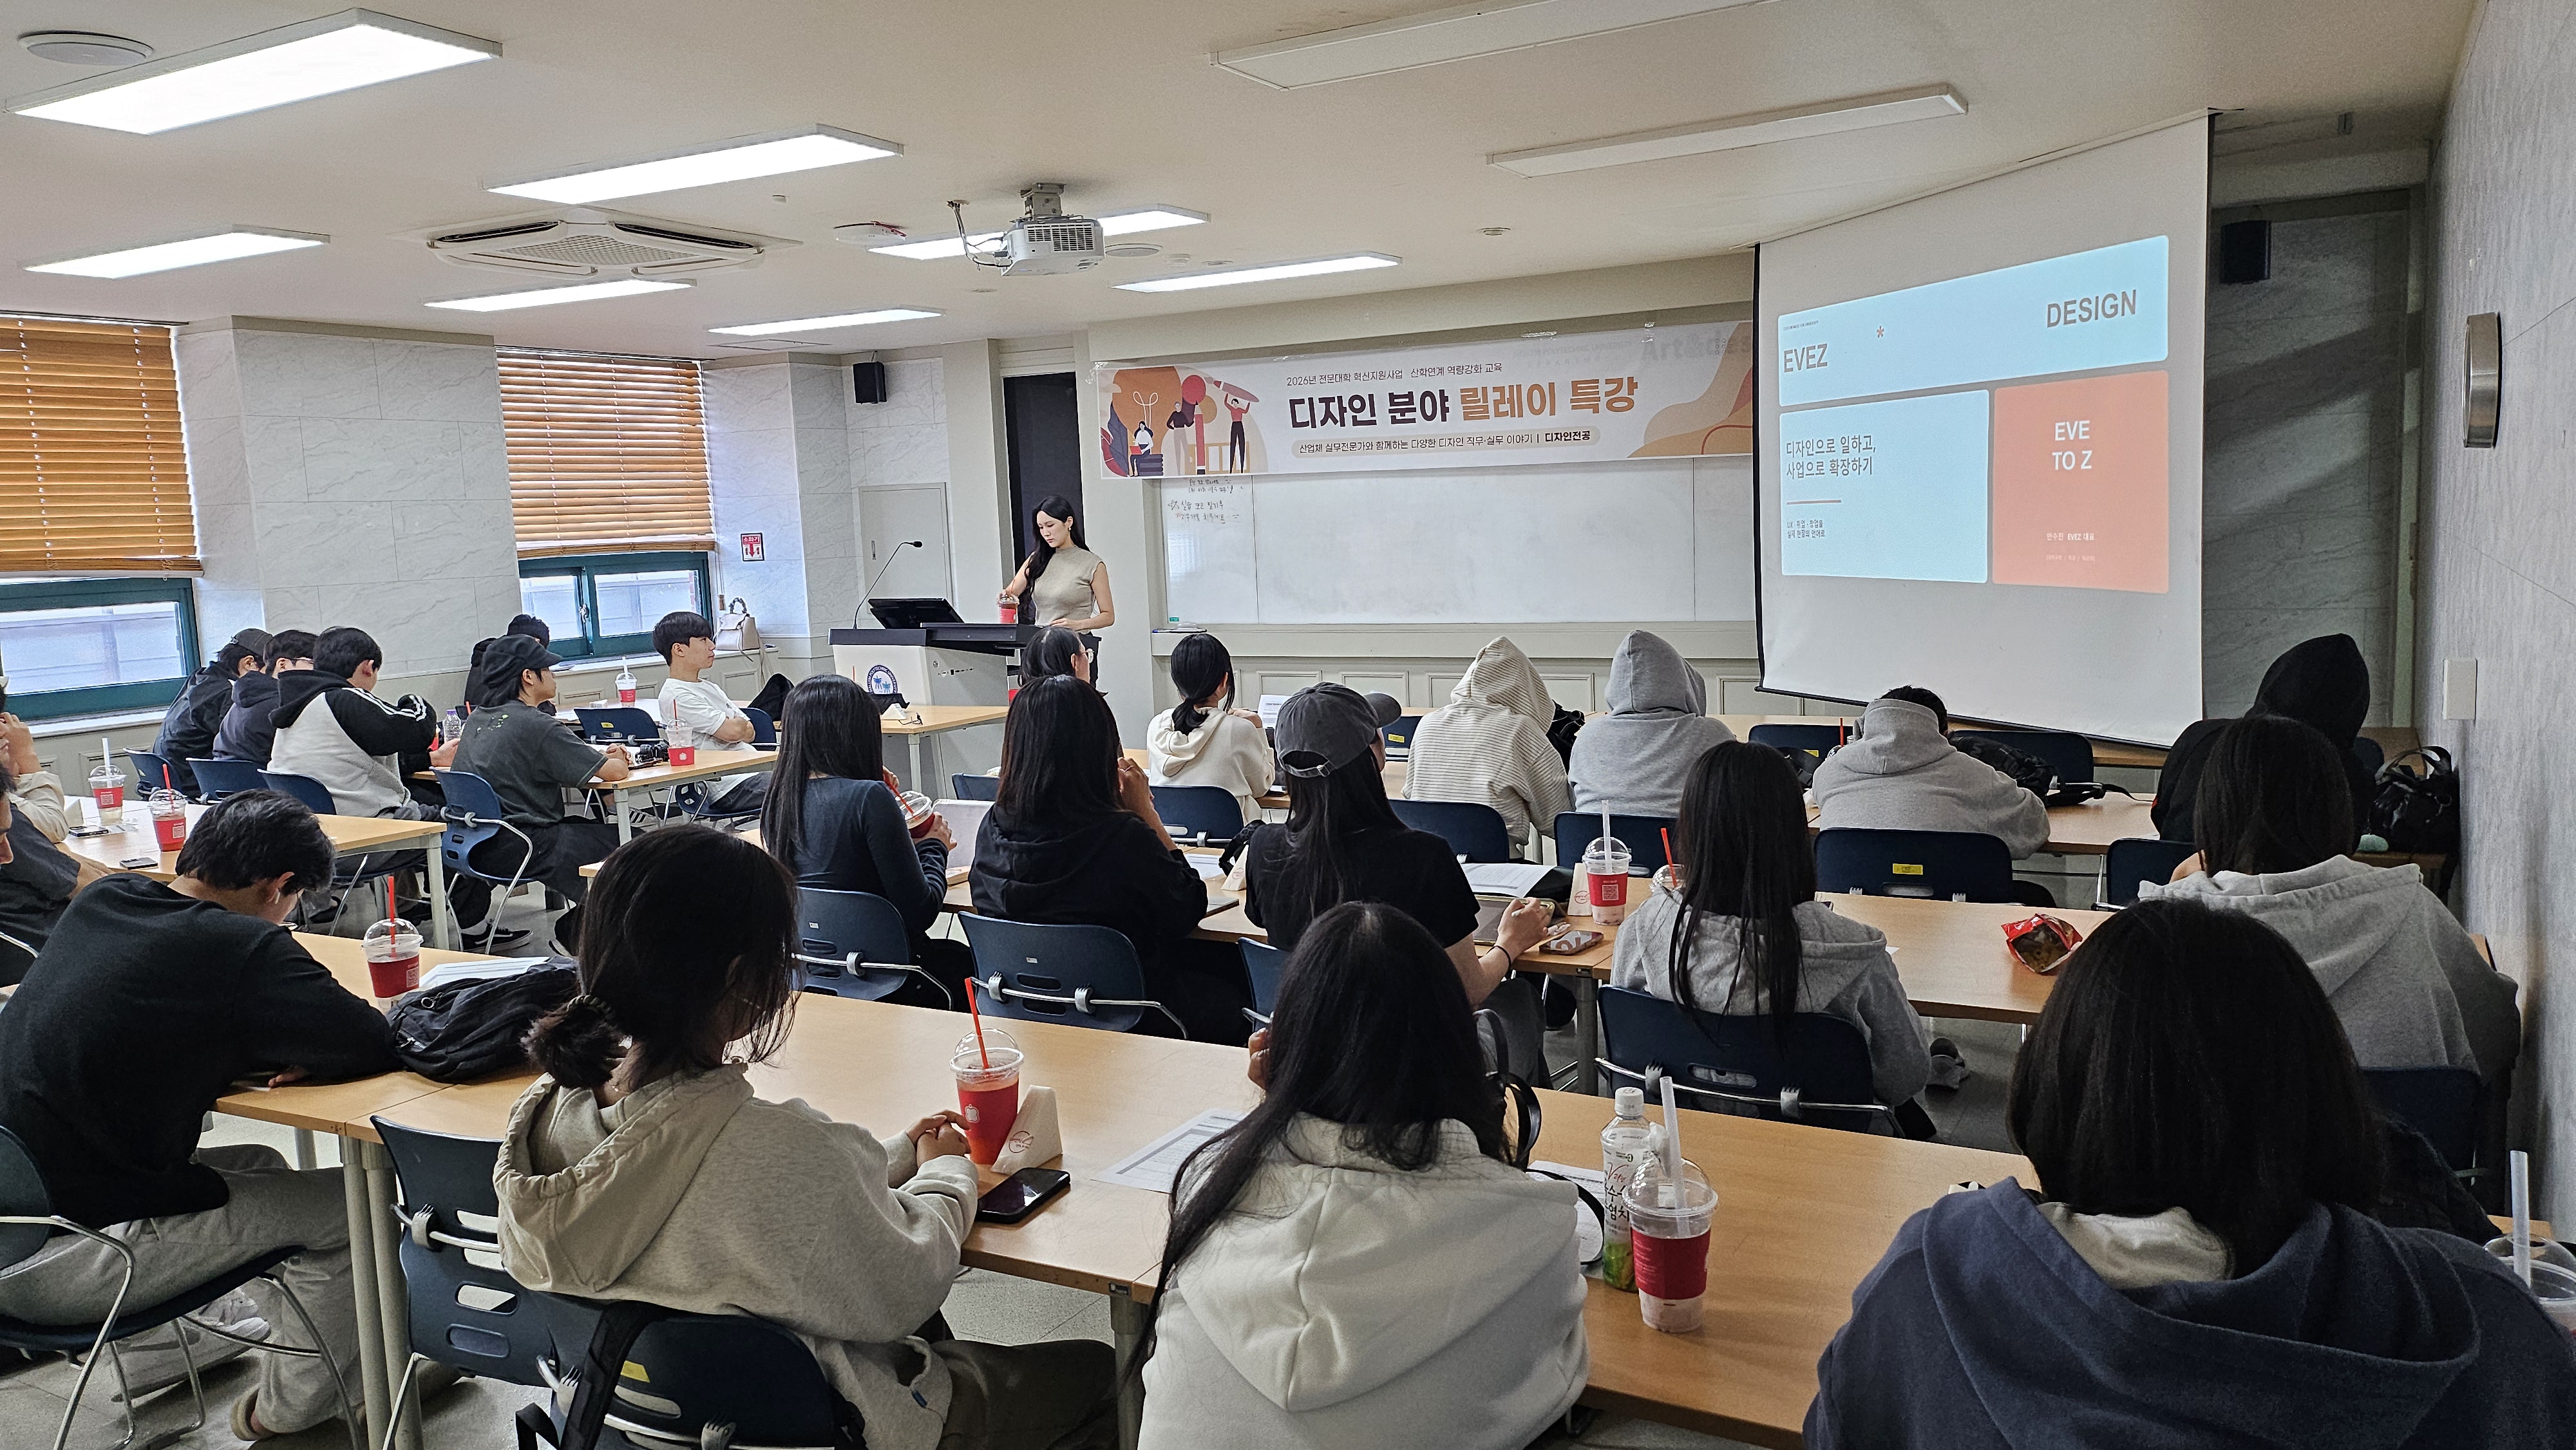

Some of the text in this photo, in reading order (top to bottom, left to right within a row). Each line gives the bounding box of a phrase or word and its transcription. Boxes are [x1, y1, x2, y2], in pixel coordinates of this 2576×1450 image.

[2047, 289, 2136, 328] DESIGN
[1784, 343, 1828, 373] EVEZ
[1287, 362, 1502, 386] 2026년 전문대학 혁신지원사업 산학연계 역량강화 교육
[1289, 376, 1638, 428] 디자인 분야 릴레이 특강
[1300, 443, 1323, 453] 산업체
[1325, 441, 1373, 452] 실무전문가와
[1376, 440, 1408, 450] 함께하는
[1411, 438, 1436, 449] 다양한
[1439, 437, 1464, 447] 디자인
[1466, 435, 1504, 446] 직무·실무
[1506, 433, 1532, 444] 이야기
[1545, 430, 1591, 442] 디자인전공
[2055, 420, 2090, 440] EVE
[1786, 435, 1876, 458] 디자인으로 일하고,
[1786, 457, 1872, 480] 사업으로 확장하기
[2052, 450, 2092, 470] TO Z
